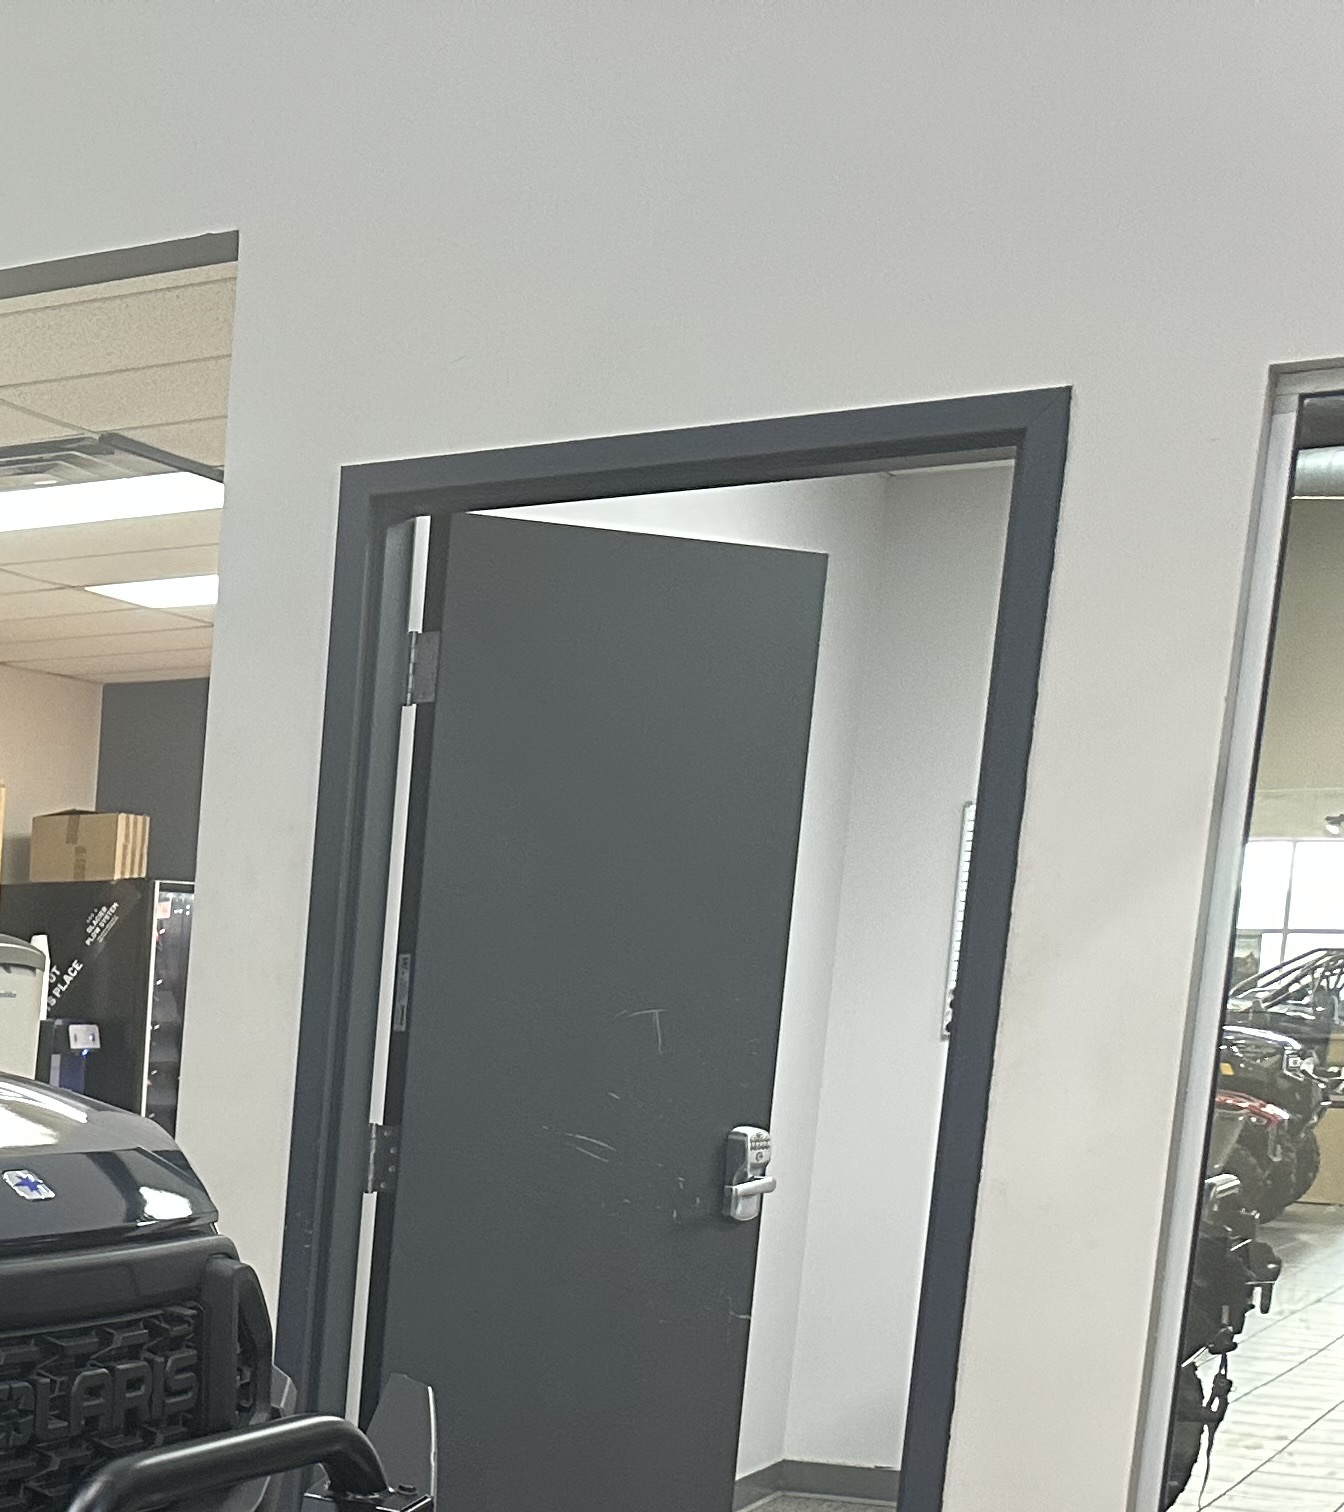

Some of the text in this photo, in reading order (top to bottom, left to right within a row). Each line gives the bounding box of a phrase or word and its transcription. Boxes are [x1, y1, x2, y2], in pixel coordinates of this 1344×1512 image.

[85, 926, 101, 946] PLOW
[98, 902, 119, 928] SYSTEM
[52, 959, 84, 998] PLACE
